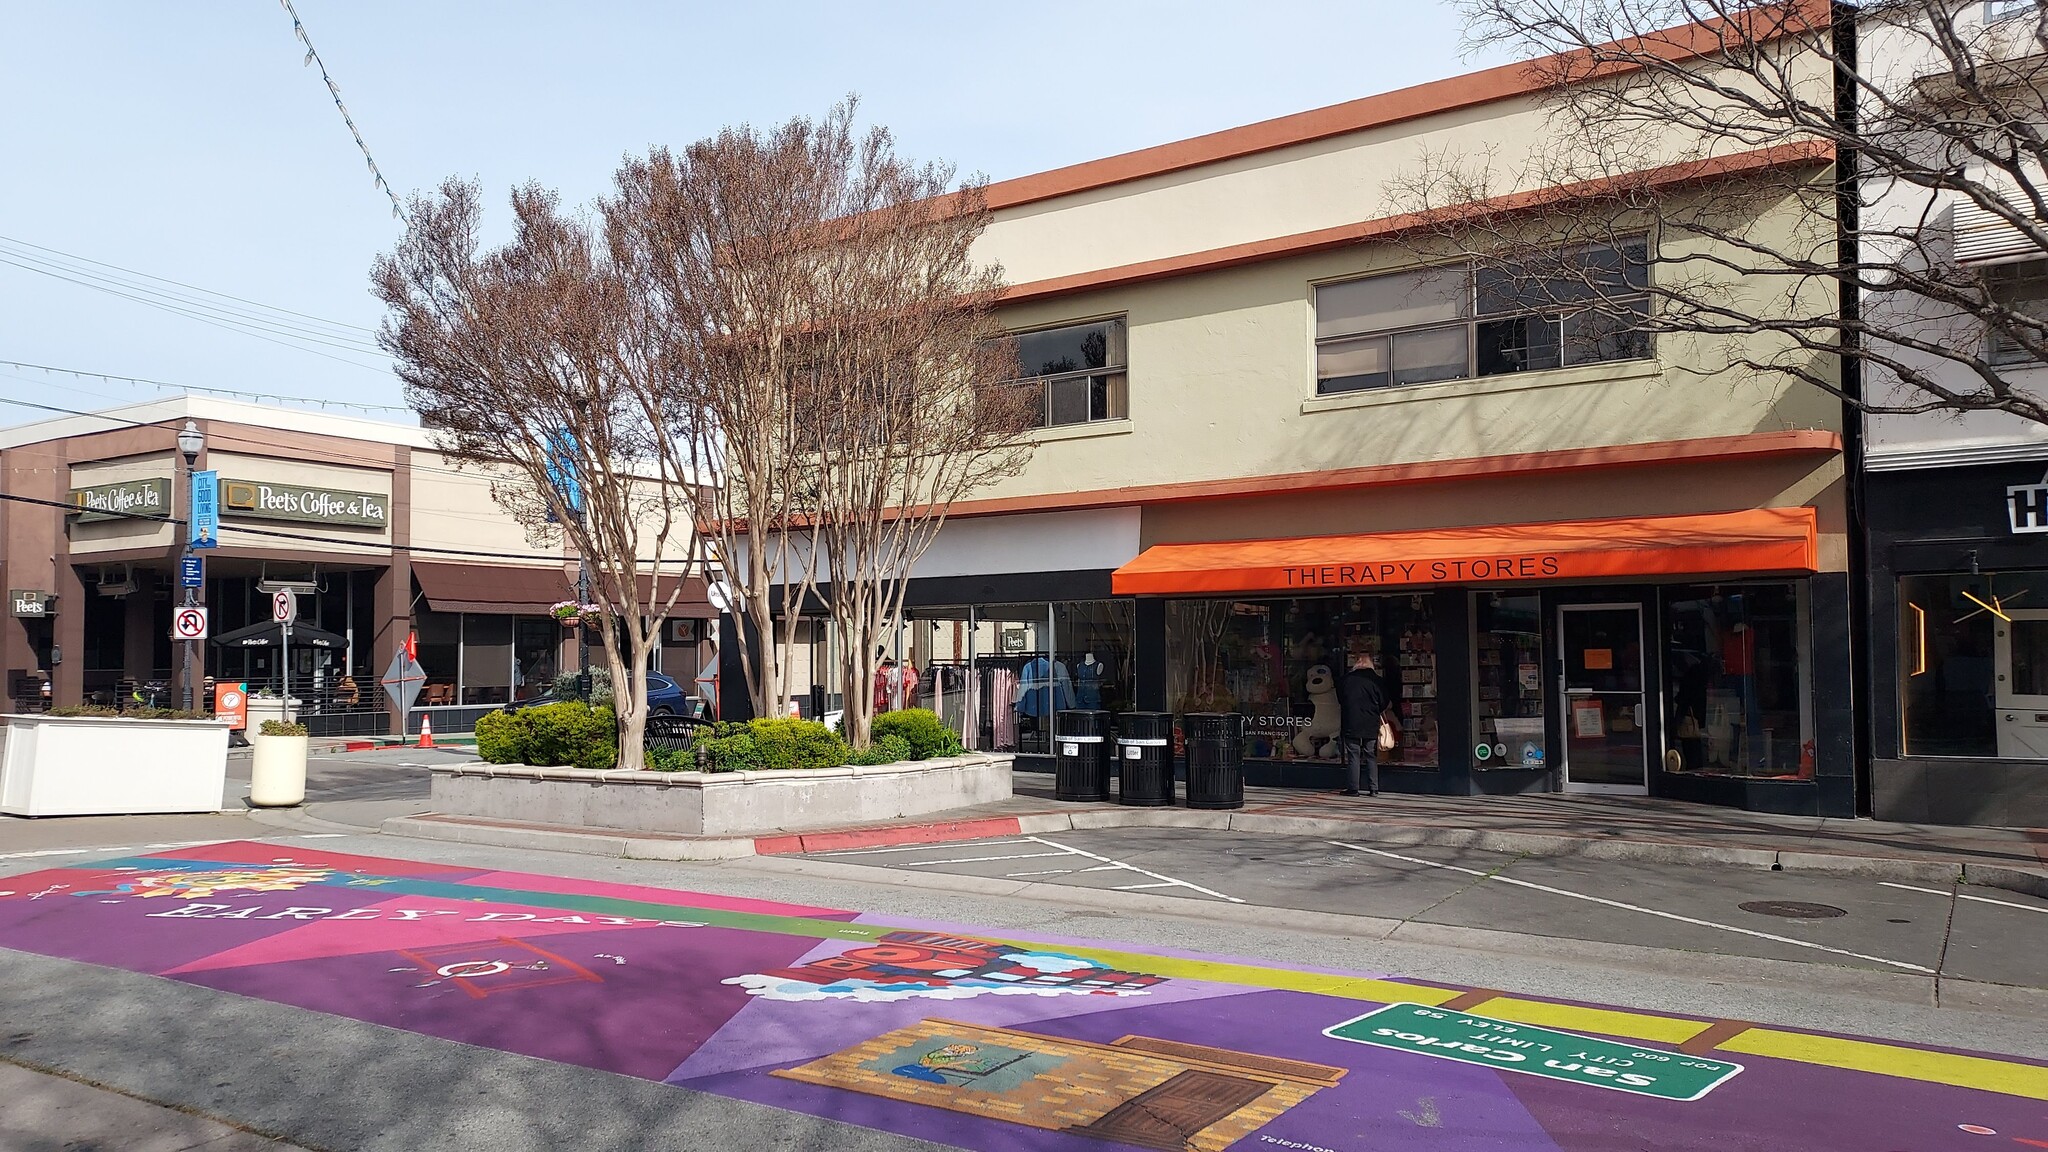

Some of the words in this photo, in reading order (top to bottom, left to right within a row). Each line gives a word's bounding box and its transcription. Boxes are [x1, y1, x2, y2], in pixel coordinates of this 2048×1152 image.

[108, 487, 135, 513] Coffee
[135, 491, 143, 505] &
[142, 484, 159, 507] Tea
[258, 486, 298, 511] Peet's
[301, 491, 345, 517] Coffee
[347, 501, 360, 514] &
[357, 496, 384, 519] Tea
[1283, 563, 1416, 585] THERAPY
[1431, 557, 1559, 580] STORES
[1259, 716, 1312, 727] STORES
[145, 903, 459, 920] EARLY
[465, 911, 710, 928] DAYS
[1412, 1009, 1449, 1019] 58
[1457, 1018, 1518, 1033] ELEV
[1372, 1028, 1527, 1062] Carlos
[1469, 1033, 1553, 1052] LIMIT
[1567, 1052, 1635, 1067] CITY
[1632, 1052, 1670, 1062] 600
[1680, 1061, 1721, 1071] POP
[1544, 1059, 1658, 1086] San
